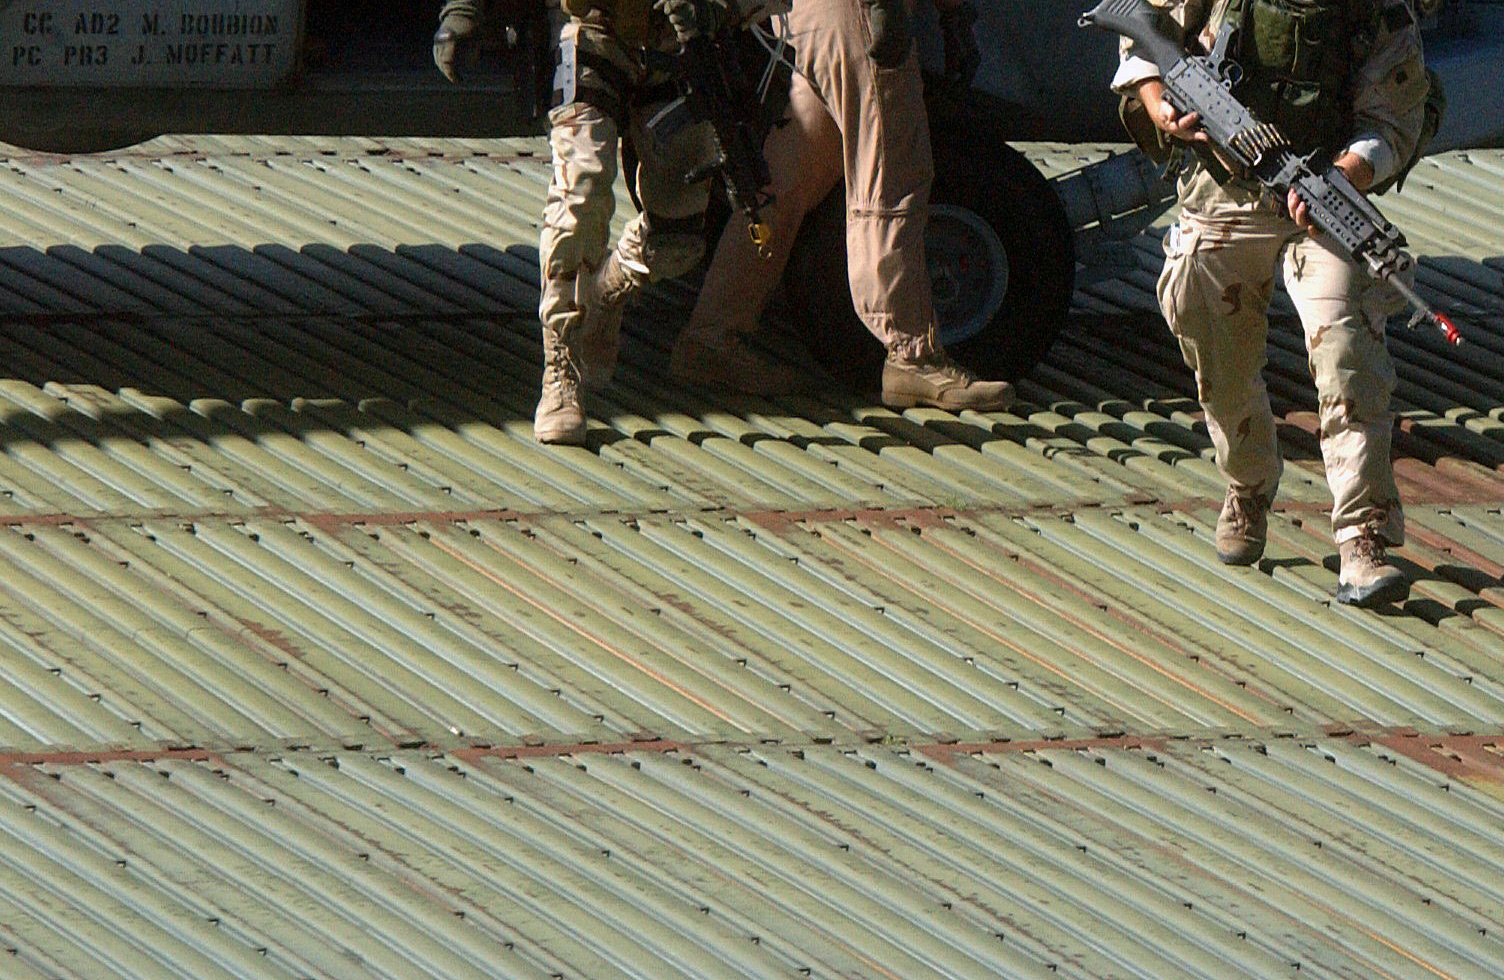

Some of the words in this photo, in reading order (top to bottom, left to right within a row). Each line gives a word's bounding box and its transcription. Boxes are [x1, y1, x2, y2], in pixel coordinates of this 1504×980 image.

[24, 12, 53, 35] CC
[75, 13, 120, 35] AD2
[143, 13, 166, 35] M.
[12, 45, 42, 69] PC
[64, 45, 109, 69] PR3
[166, 43, 278, 65] MOFFATT
